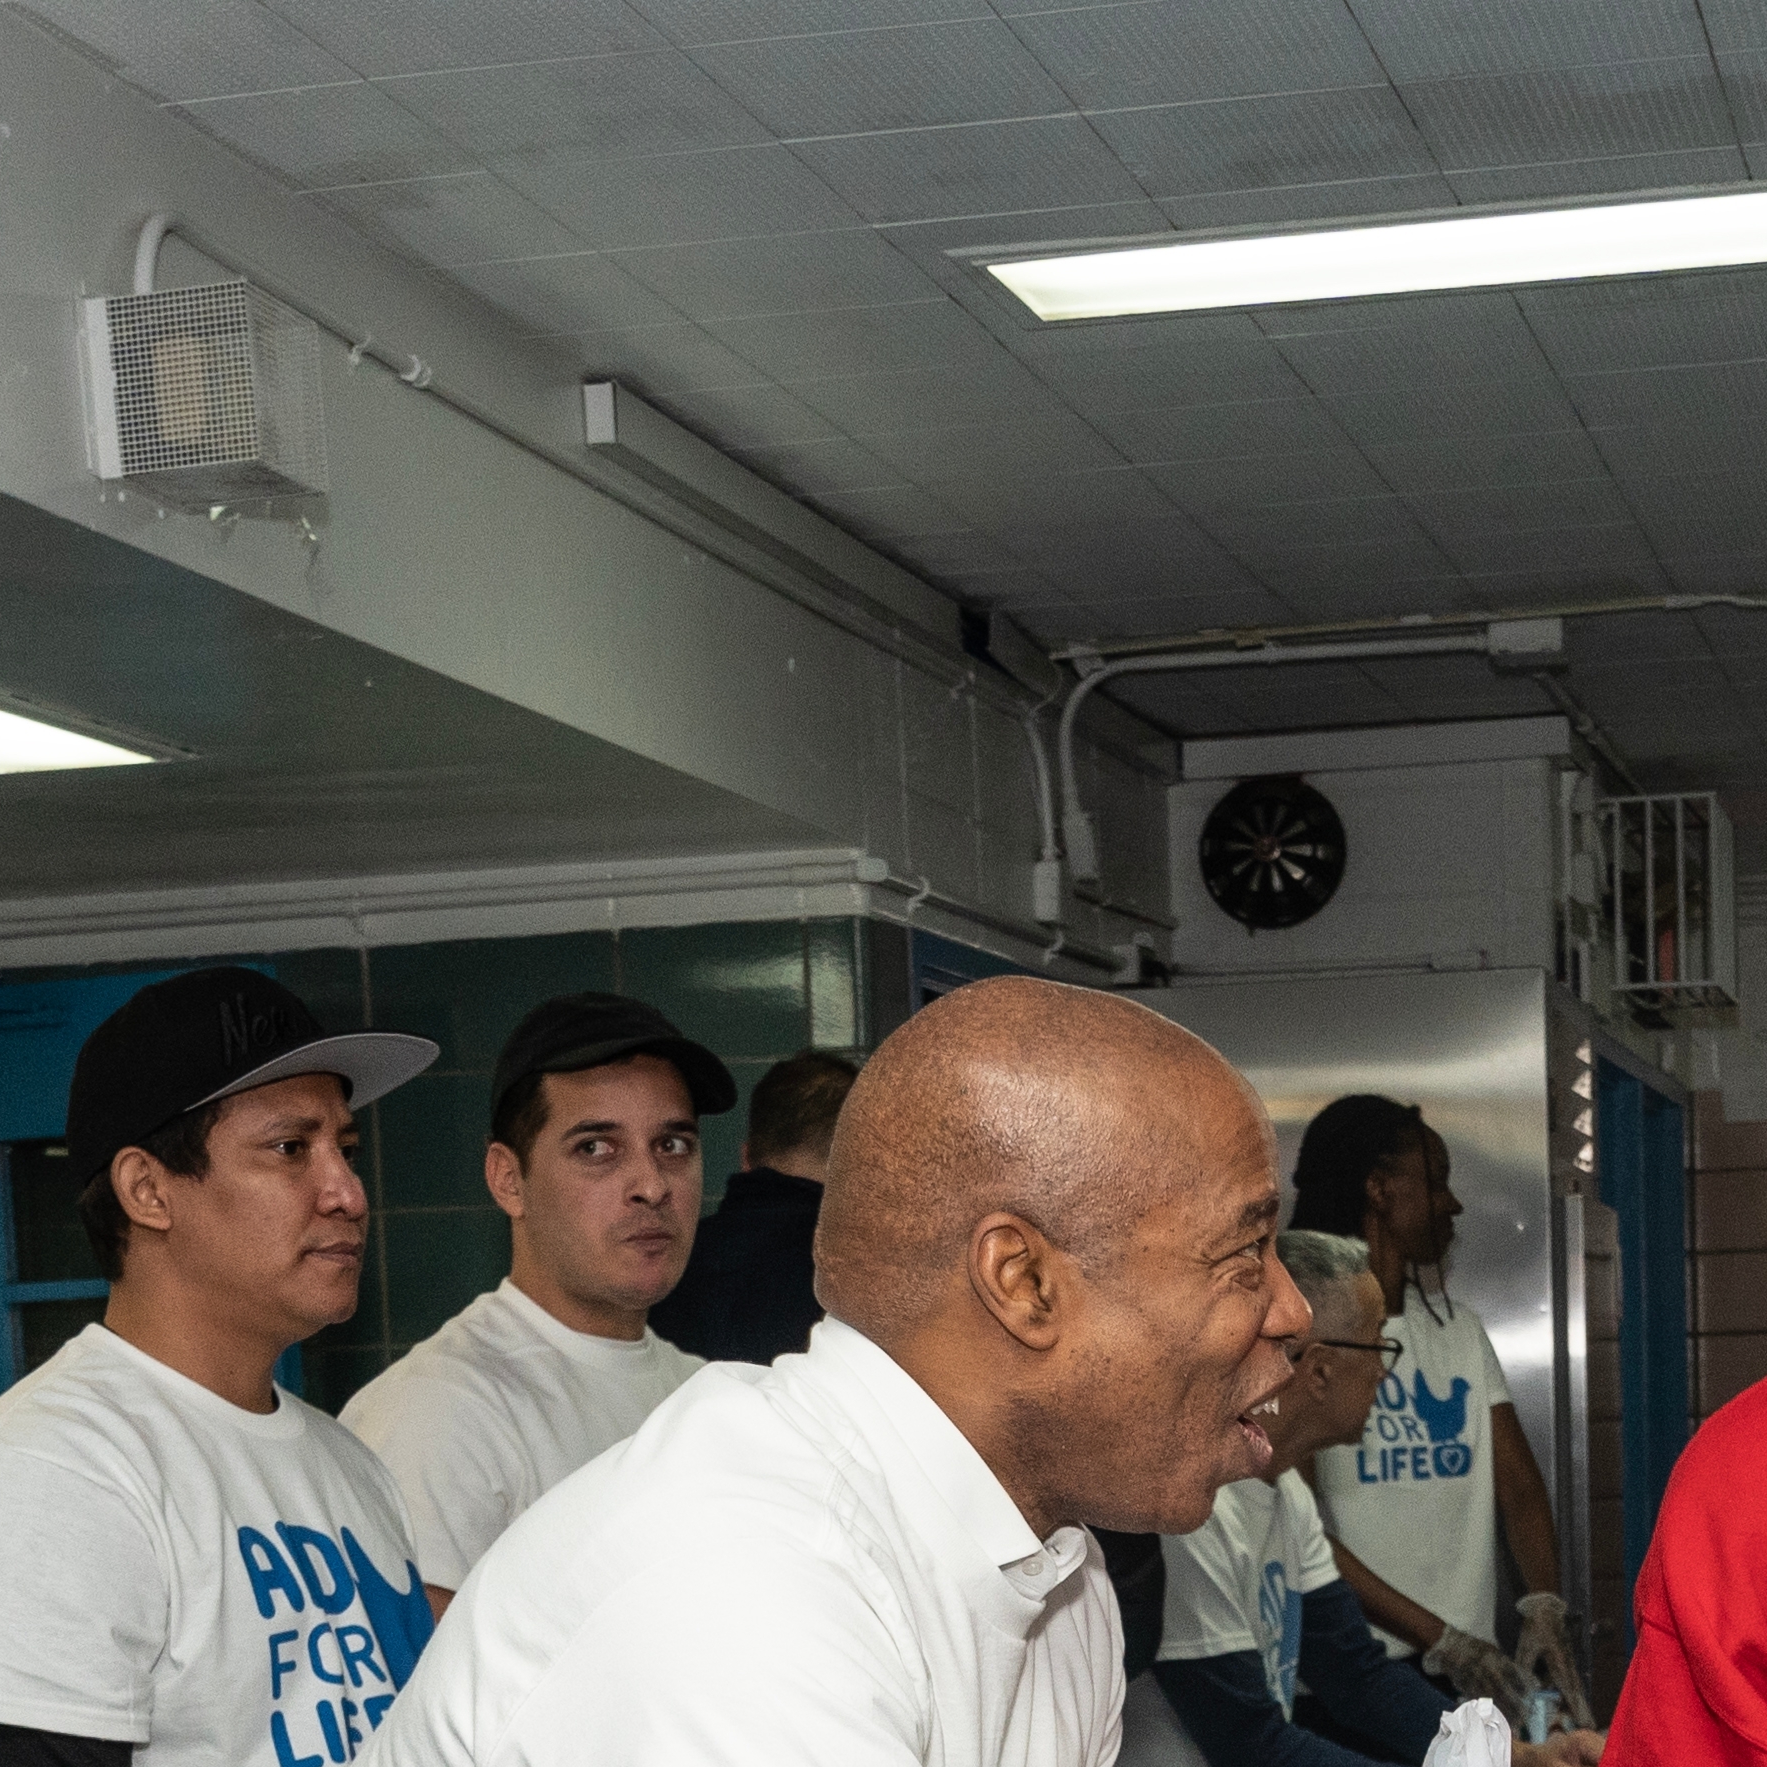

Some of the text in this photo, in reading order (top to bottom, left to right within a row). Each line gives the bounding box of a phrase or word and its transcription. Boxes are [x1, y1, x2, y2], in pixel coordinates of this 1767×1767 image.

[1364, 1414, 1423, 1442] OR
[1357, 1446, 1432, 1483] LIFE
[269, 1622, 387, 1700] FOR
